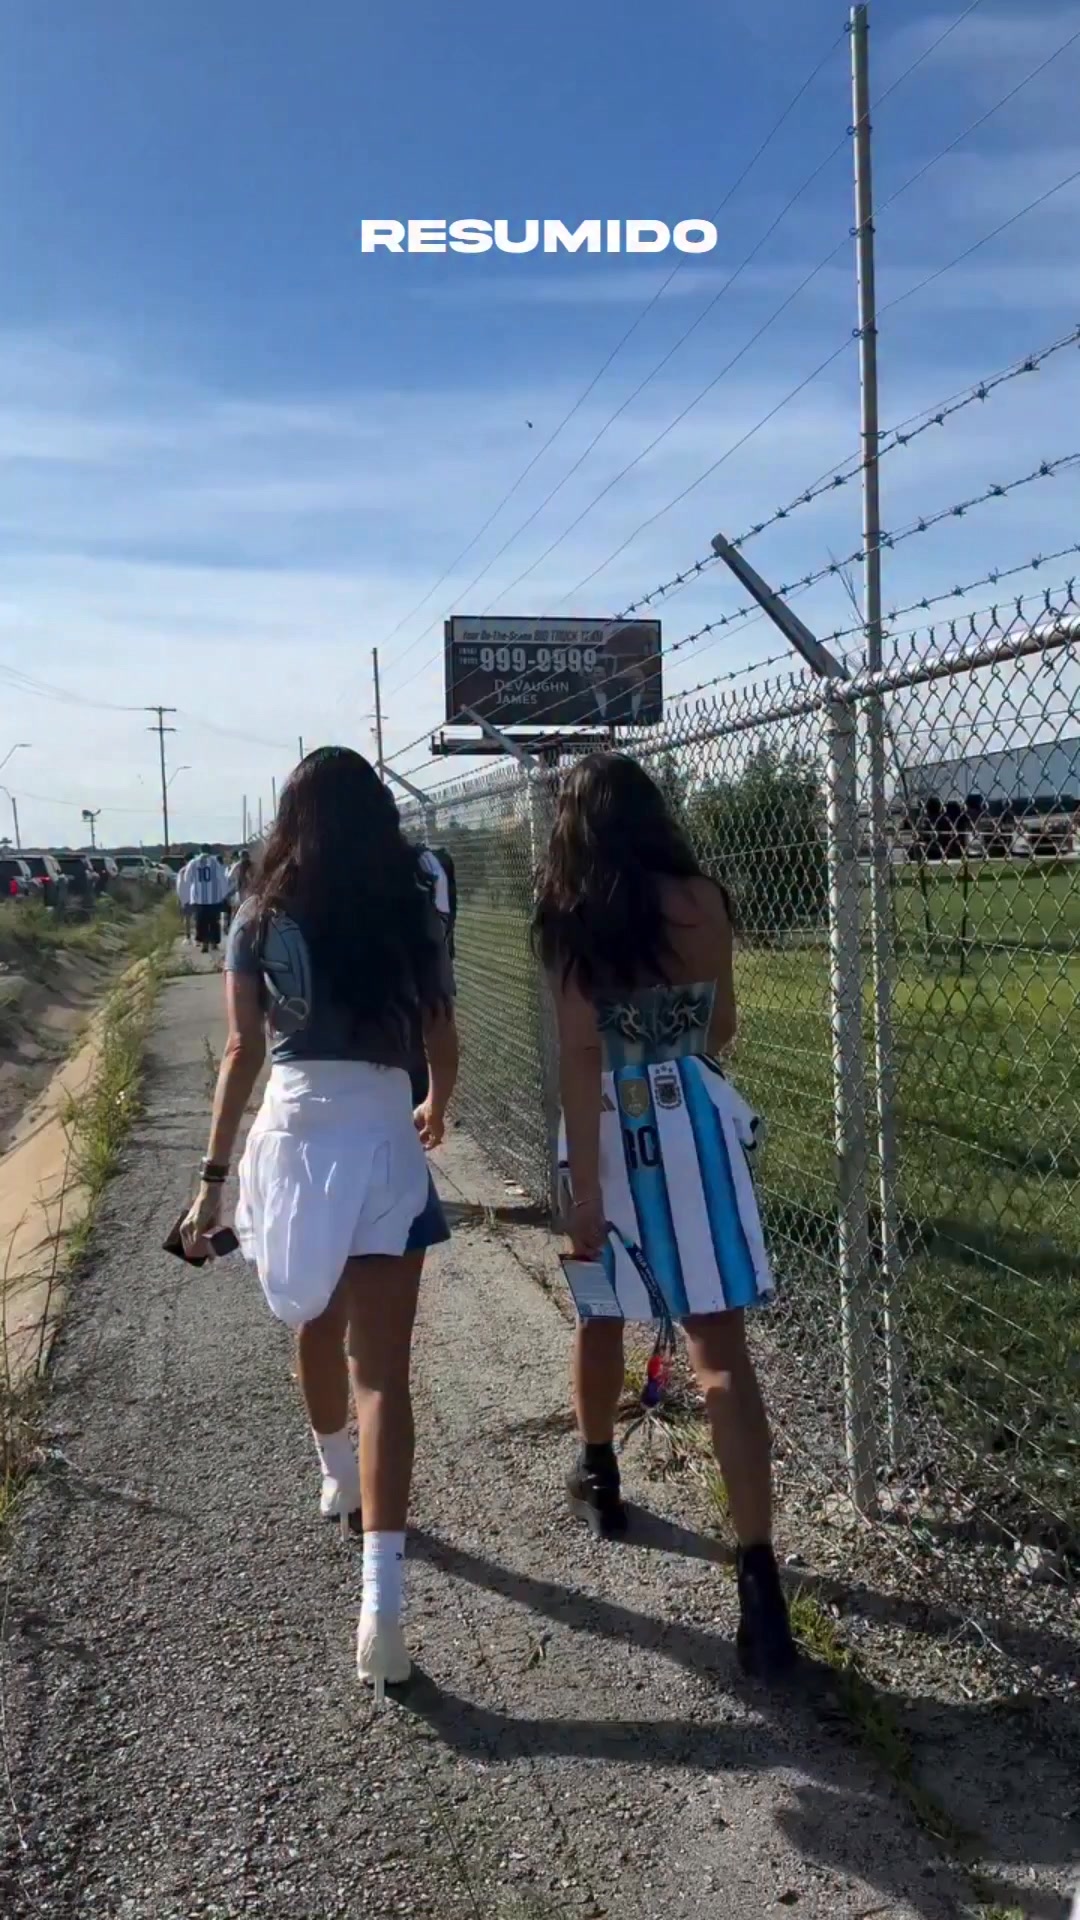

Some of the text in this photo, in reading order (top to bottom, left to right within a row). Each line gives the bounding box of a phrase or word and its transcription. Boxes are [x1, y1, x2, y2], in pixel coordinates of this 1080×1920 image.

[480, 647, 597, 672] 999-9999
[197, 866, 211, 883] 10
[623, 1125, 662, 1169] 10
